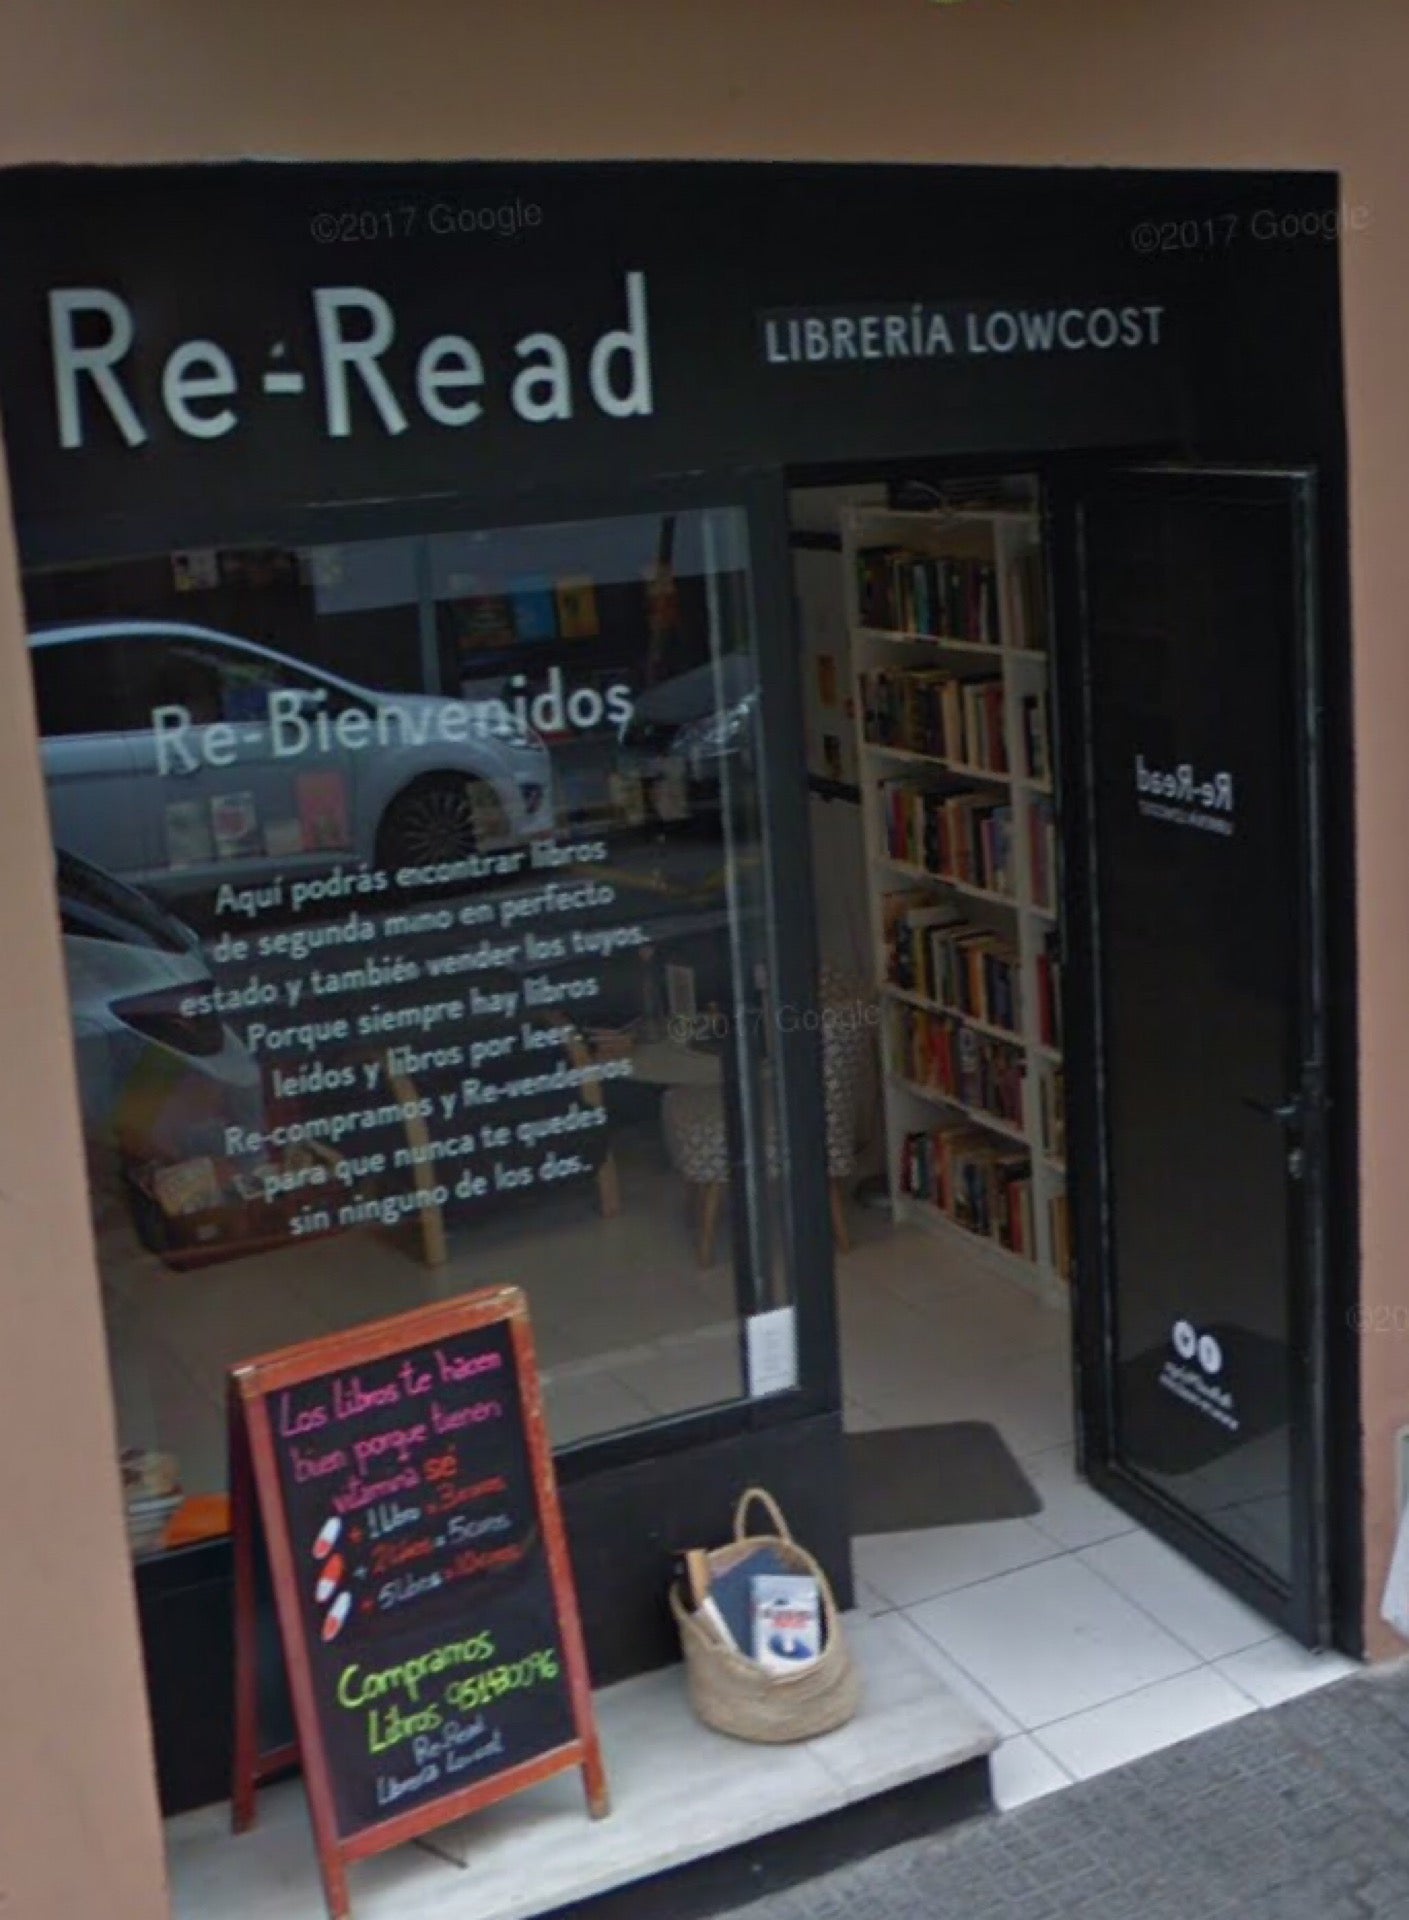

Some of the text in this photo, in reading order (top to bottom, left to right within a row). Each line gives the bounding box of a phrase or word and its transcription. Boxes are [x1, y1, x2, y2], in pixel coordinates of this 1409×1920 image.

[48, 271, 653, 449] Re-Read
[765, 304, 1163, 363] LIBRERÍA LOWCOST
[152, 667, 635, 778] Re-Bienvenidos
[213, 929, 248, 963] de
[258, 915, 375, 961] segunda
[459, 897, 495, 925] en
[500, 880, 614, 927] perfecto
[216, 840, 606, 919] Aquí podrás encontrar libros
[180, 973, 276, 1018] estado
[286, 974, 303, 1007] y
[311, 952, 419, 997] también
[426, 939, 519, 977] vender
[525, 931, 564, 959] los
[246, 972, 598, 1051] Porque siempre hay libros
[224, 1057, 633, 1156] Re-compramos y Re-vendemos
[272, 1060, 357, 1099] leídos
[363, 1062, 380, 1091] y
[387, 1044, 463, 1078] libros
[470, 1036, 515, 1067] por
[263, 1102, 607, 1204] para que nunca te quedes
[289, 1150, 593, 1236] sin ninguno de los dos.
[400, 1360, 433, 1396] te
